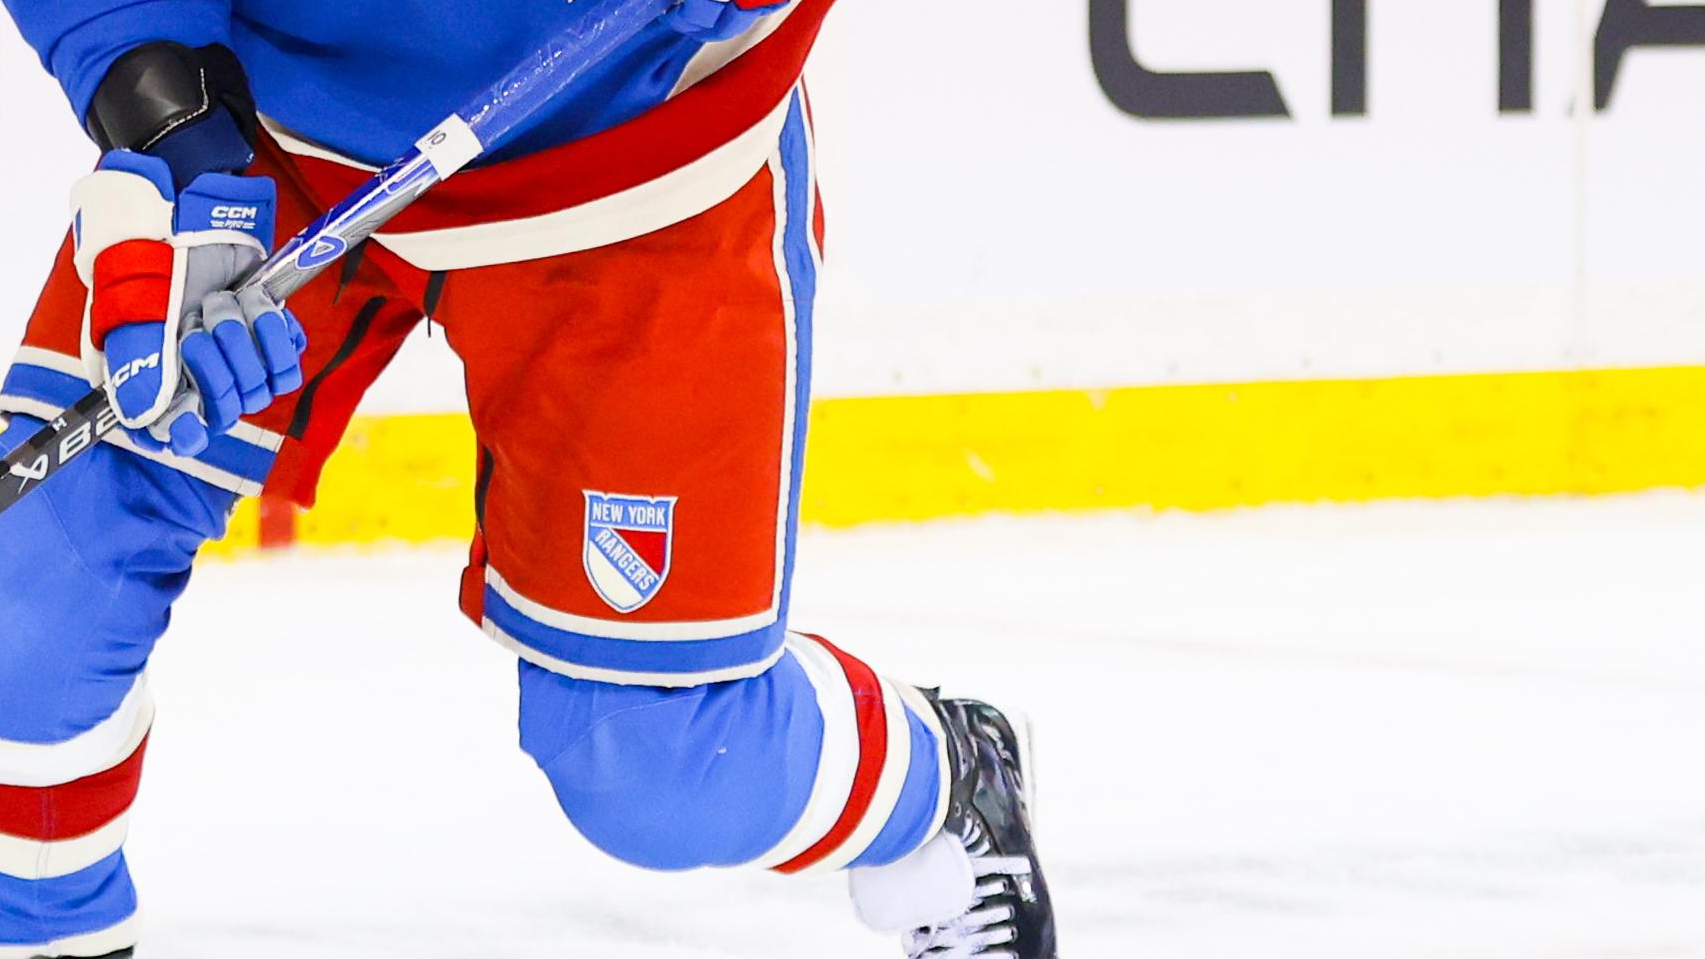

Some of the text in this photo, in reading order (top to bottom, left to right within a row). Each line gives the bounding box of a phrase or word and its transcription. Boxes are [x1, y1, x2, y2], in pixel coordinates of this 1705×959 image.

[210, 205, 258, 219] CCM
[113, 352, 160, 388] CM
[592, 502, 667, 526] NEW YORK
[595, 528, 656, 591] RANGERS
